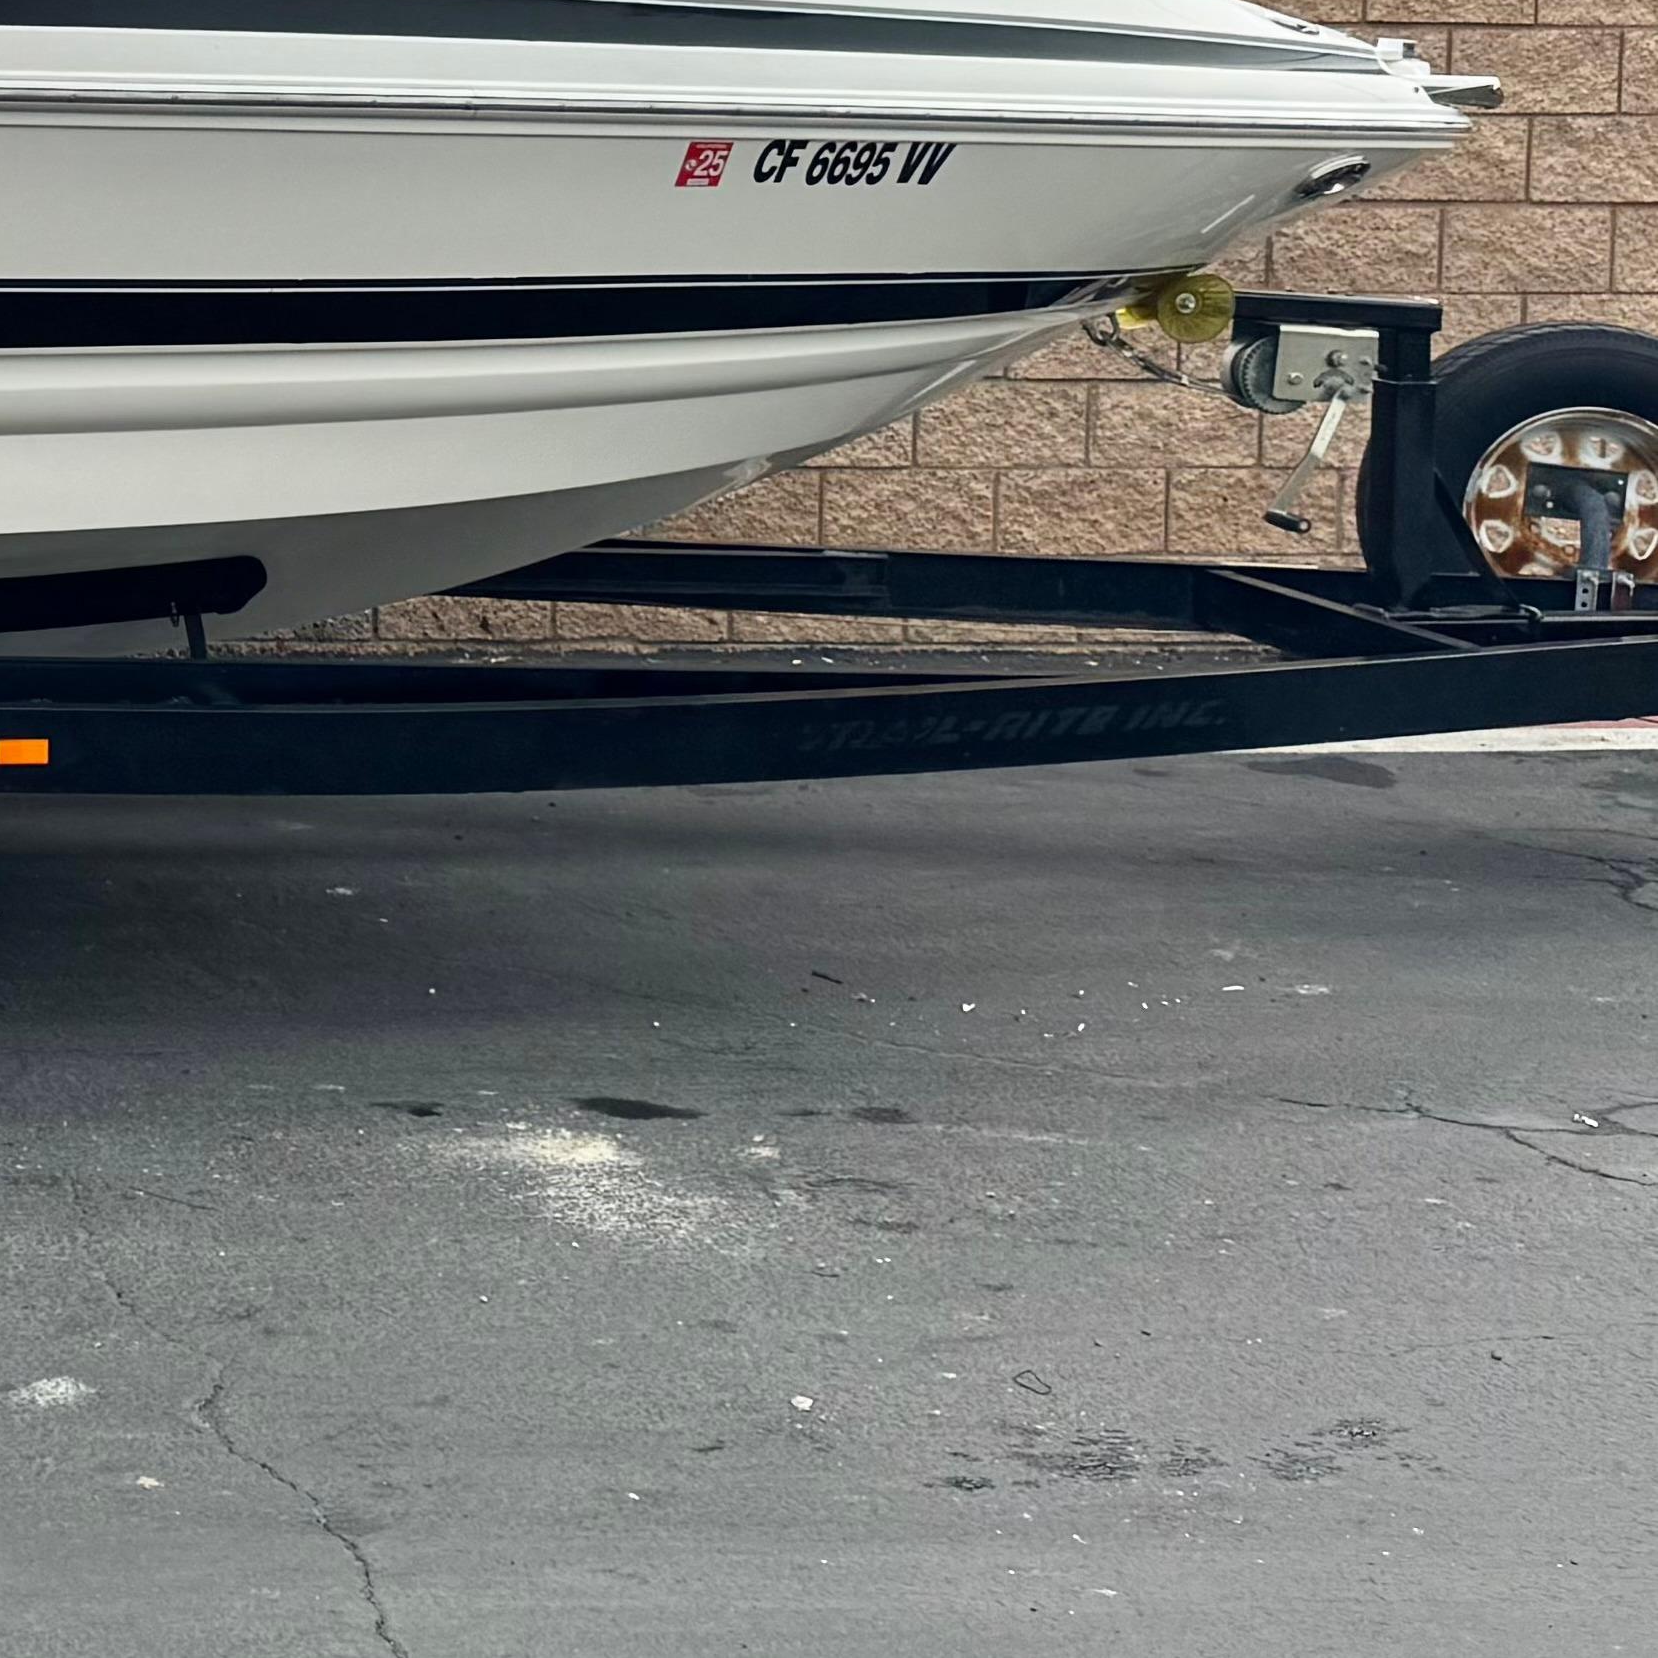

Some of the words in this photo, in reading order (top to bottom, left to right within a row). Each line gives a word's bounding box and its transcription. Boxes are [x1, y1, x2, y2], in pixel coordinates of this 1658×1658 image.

[693, 148, 728, 177] 25
[752, 138, 809, 184] CF
[805, 140, 899, 186] 6695
[896, 141, 958, 185] VV
